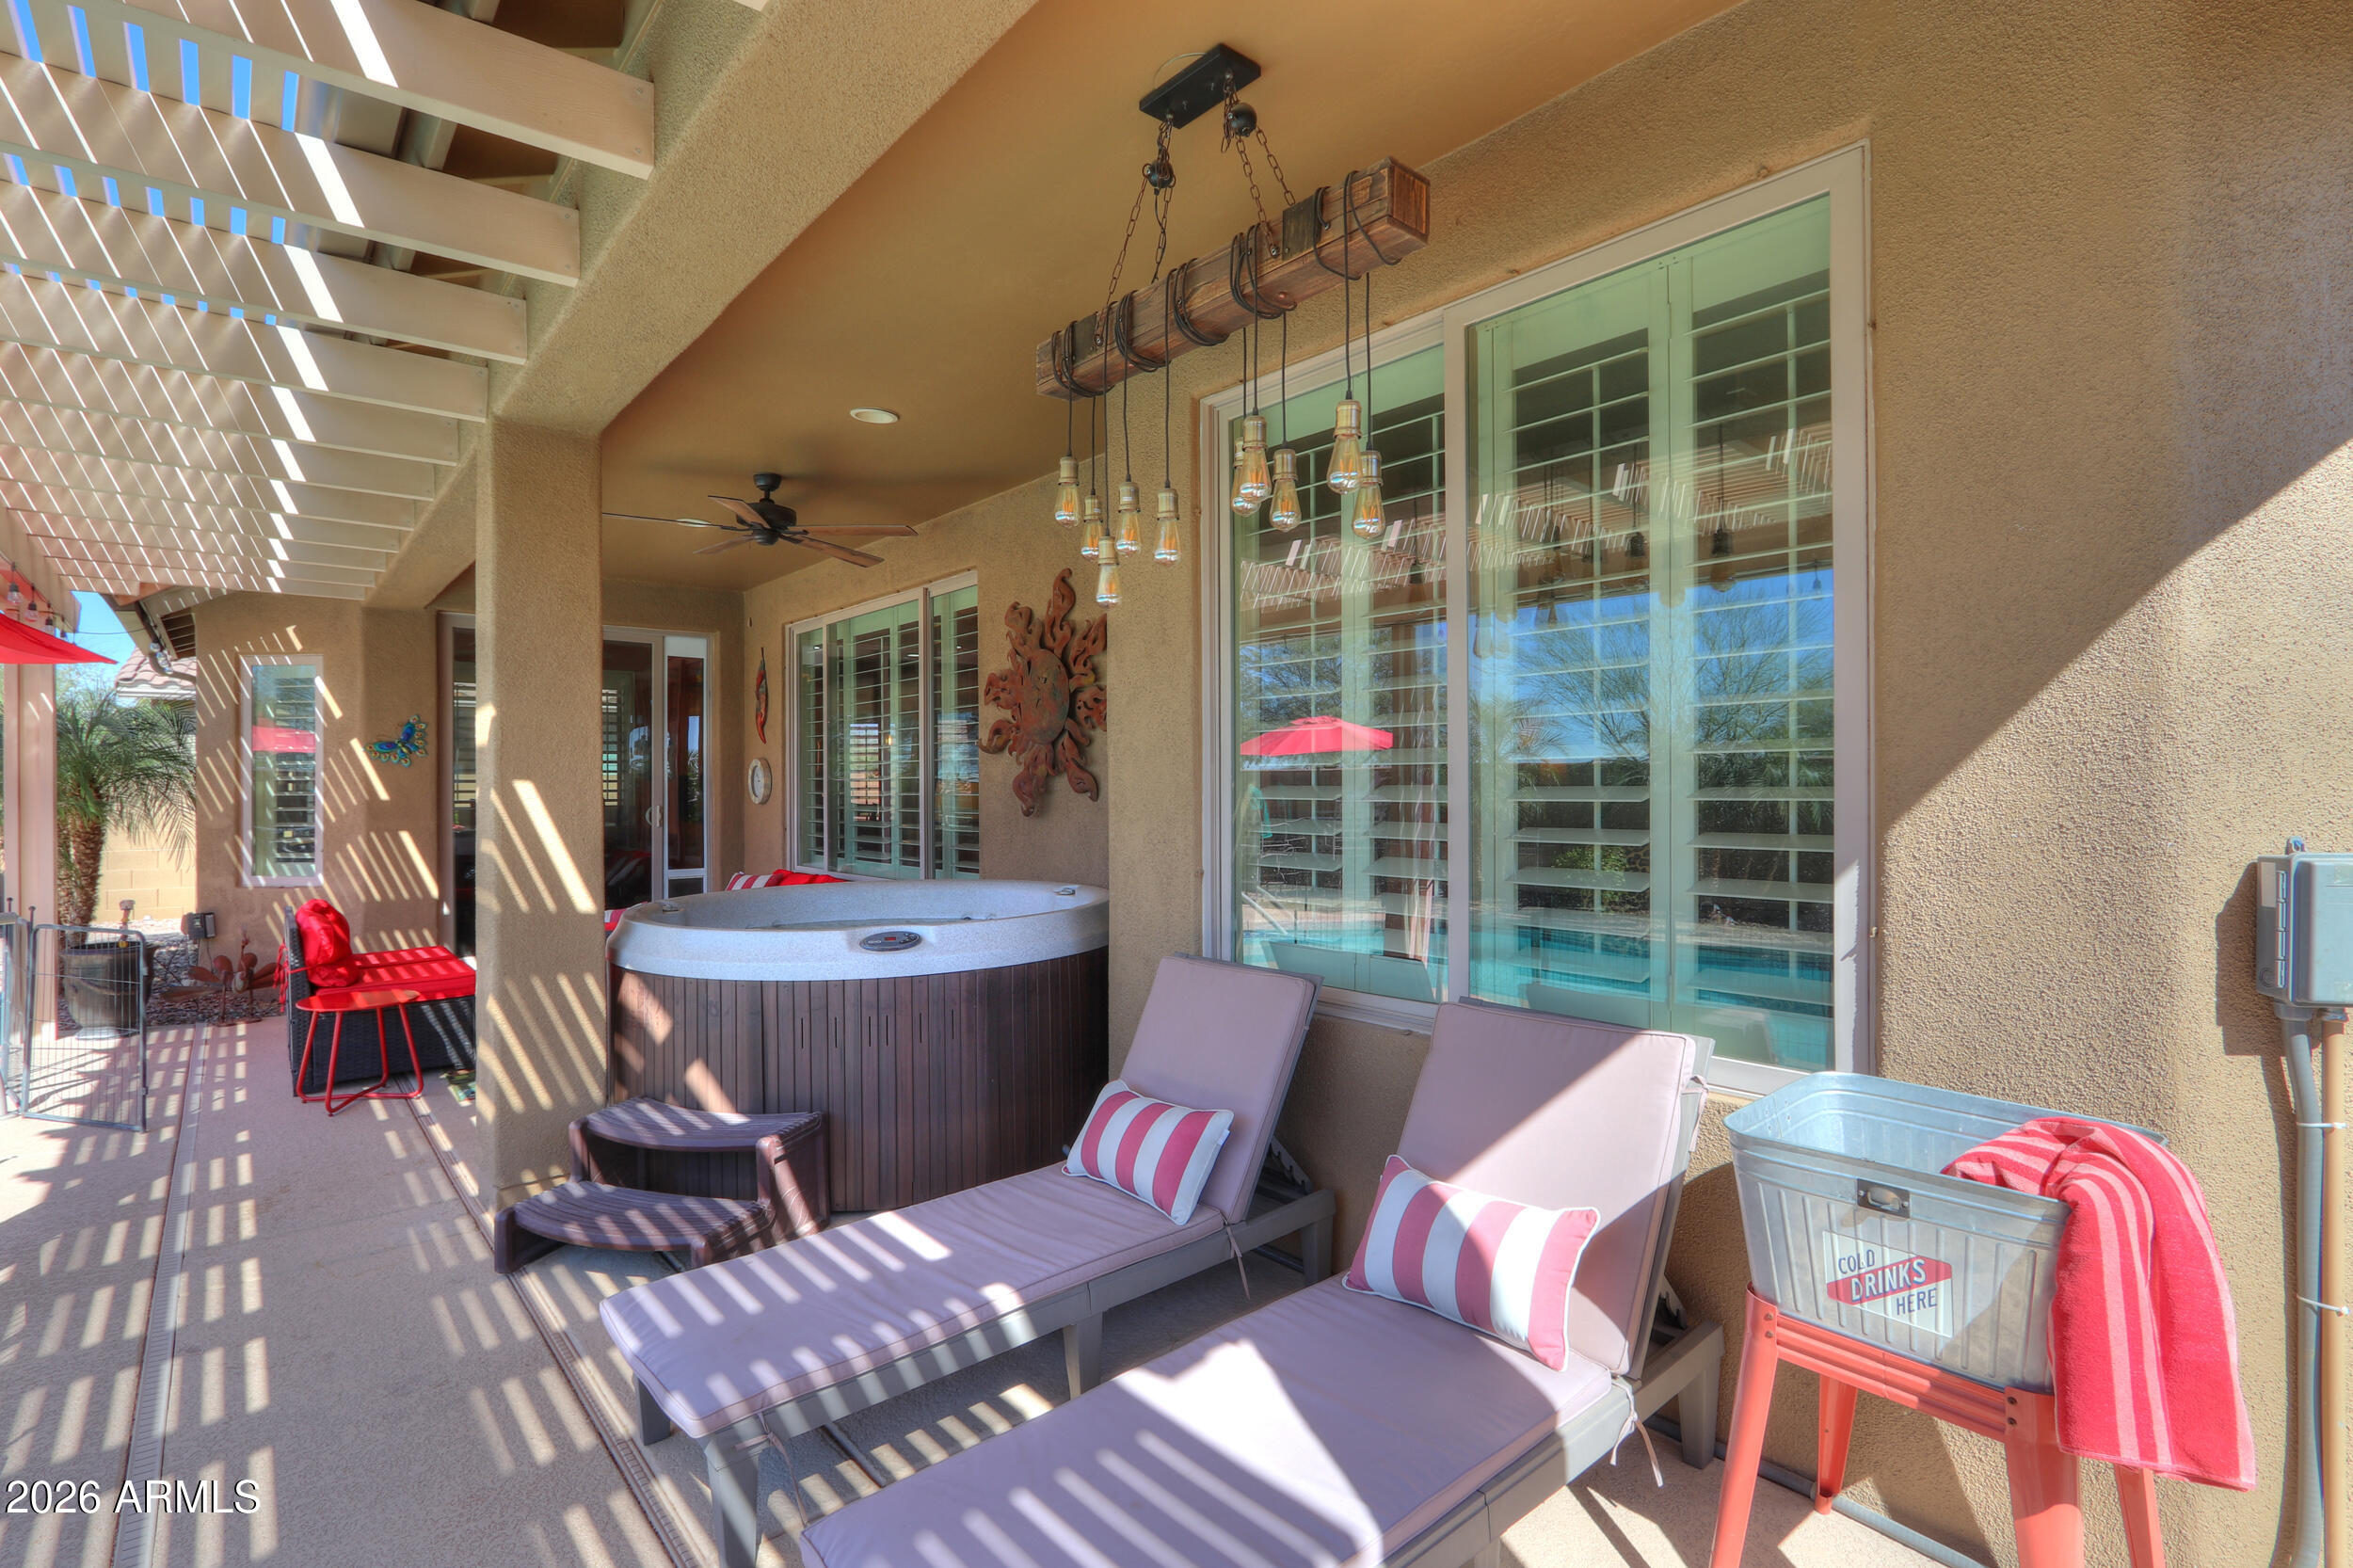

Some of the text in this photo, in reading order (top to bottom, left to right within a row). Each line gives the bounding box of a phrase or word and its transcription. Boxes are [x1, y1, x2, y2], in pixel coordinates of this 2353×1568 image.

[1838, 1249, 1876, 1274] COLD
[1850, 1258, 1927, 1303] DRINKS
[1896, 1287, 1938, 1316] HERE
